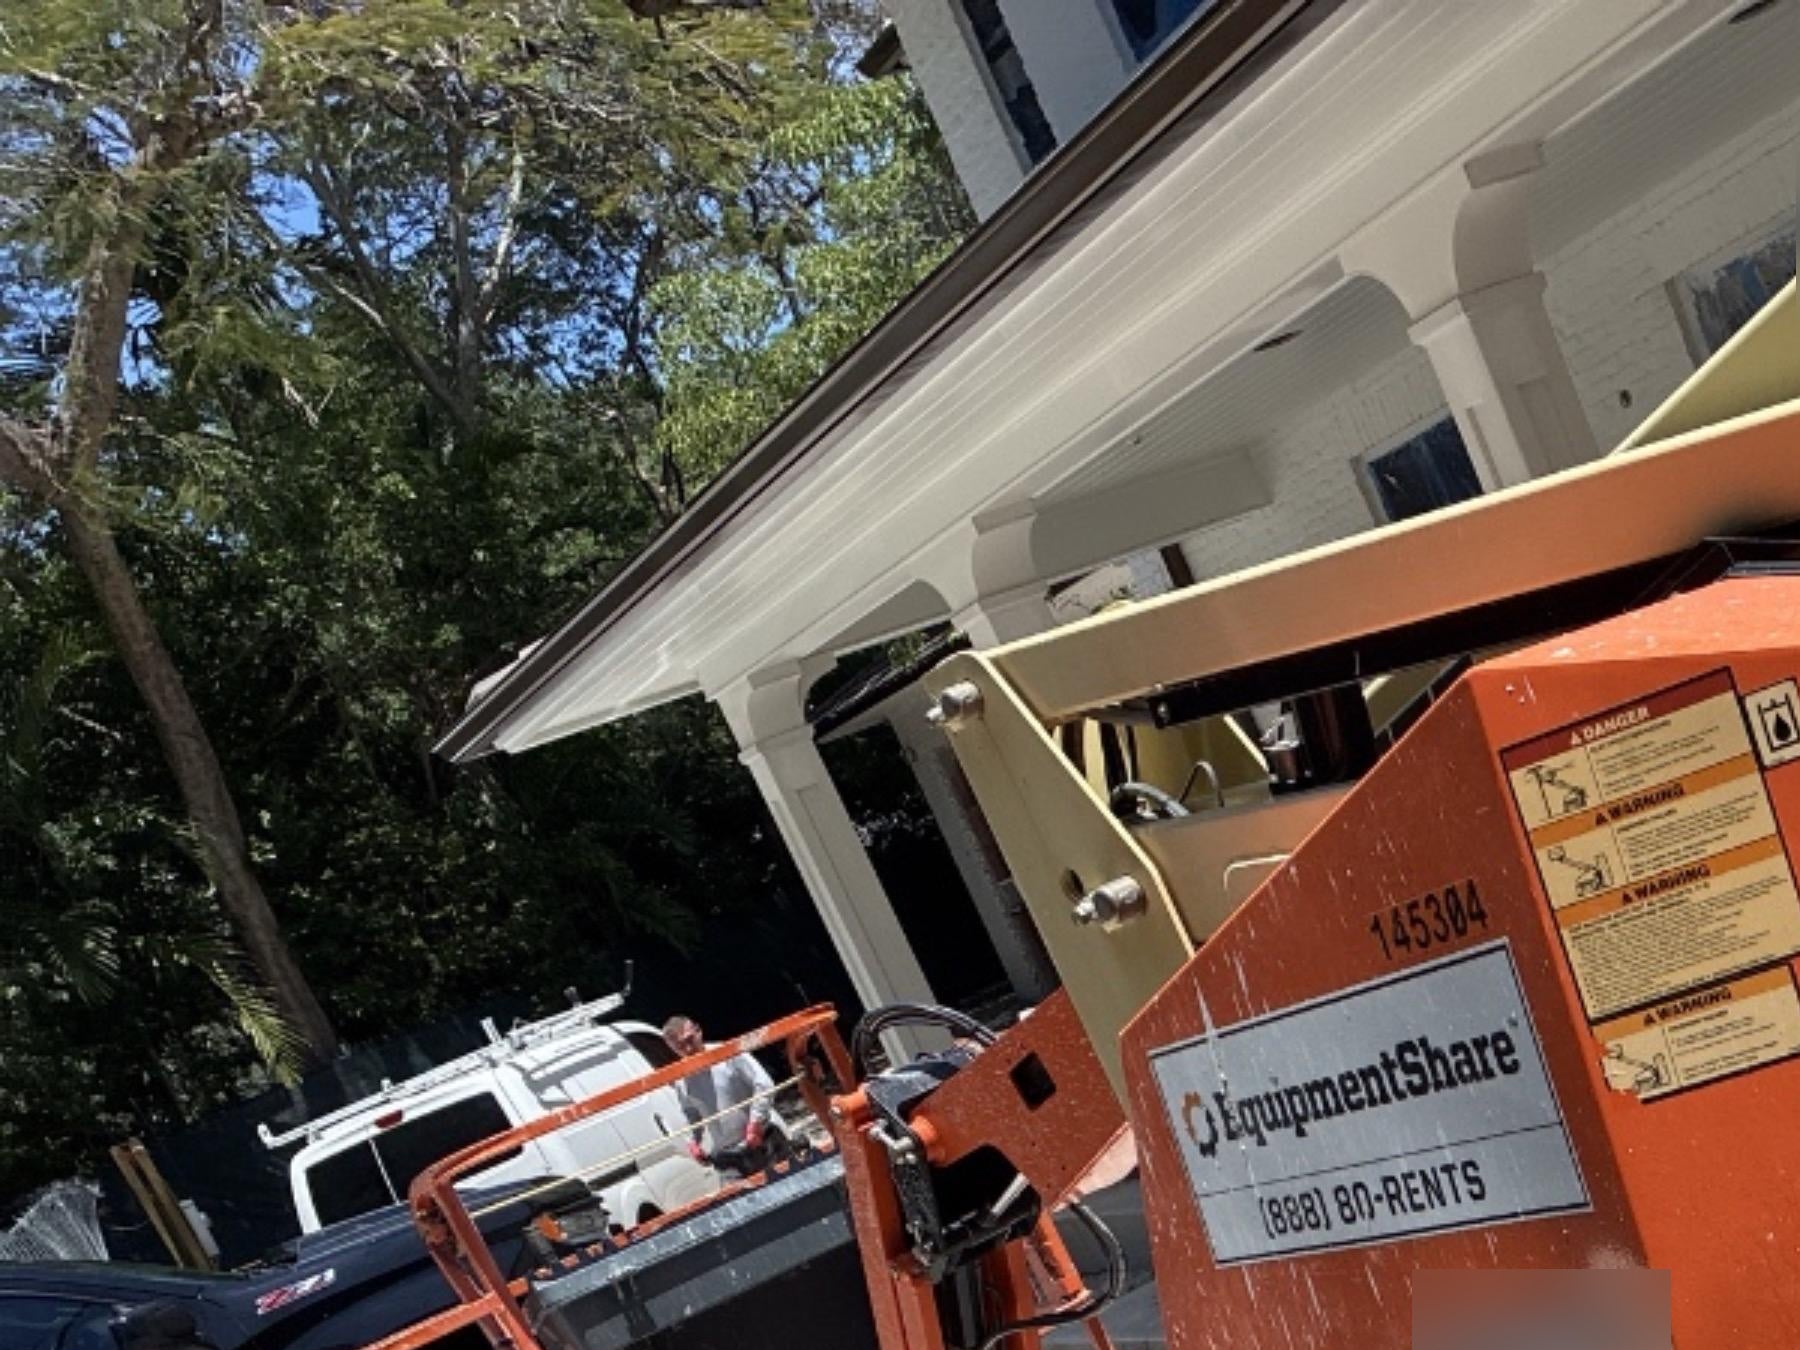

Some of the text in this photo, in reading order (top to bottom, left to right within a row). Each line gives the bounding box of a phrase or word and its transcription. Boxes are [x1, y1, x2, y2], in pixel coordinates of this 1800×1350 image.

[1584, 706, 1651, 740] DANGER
[1608, 783, 1686, 819] WARNING
[1634, 865, 1711, 902] WARNING
[1657, 988, 1733, 1025] WARNING
[1213, 1027, 1521, 1148] EquipmentShare
[1259, 1160, 1487, 1241] (888) 80-RENTS
